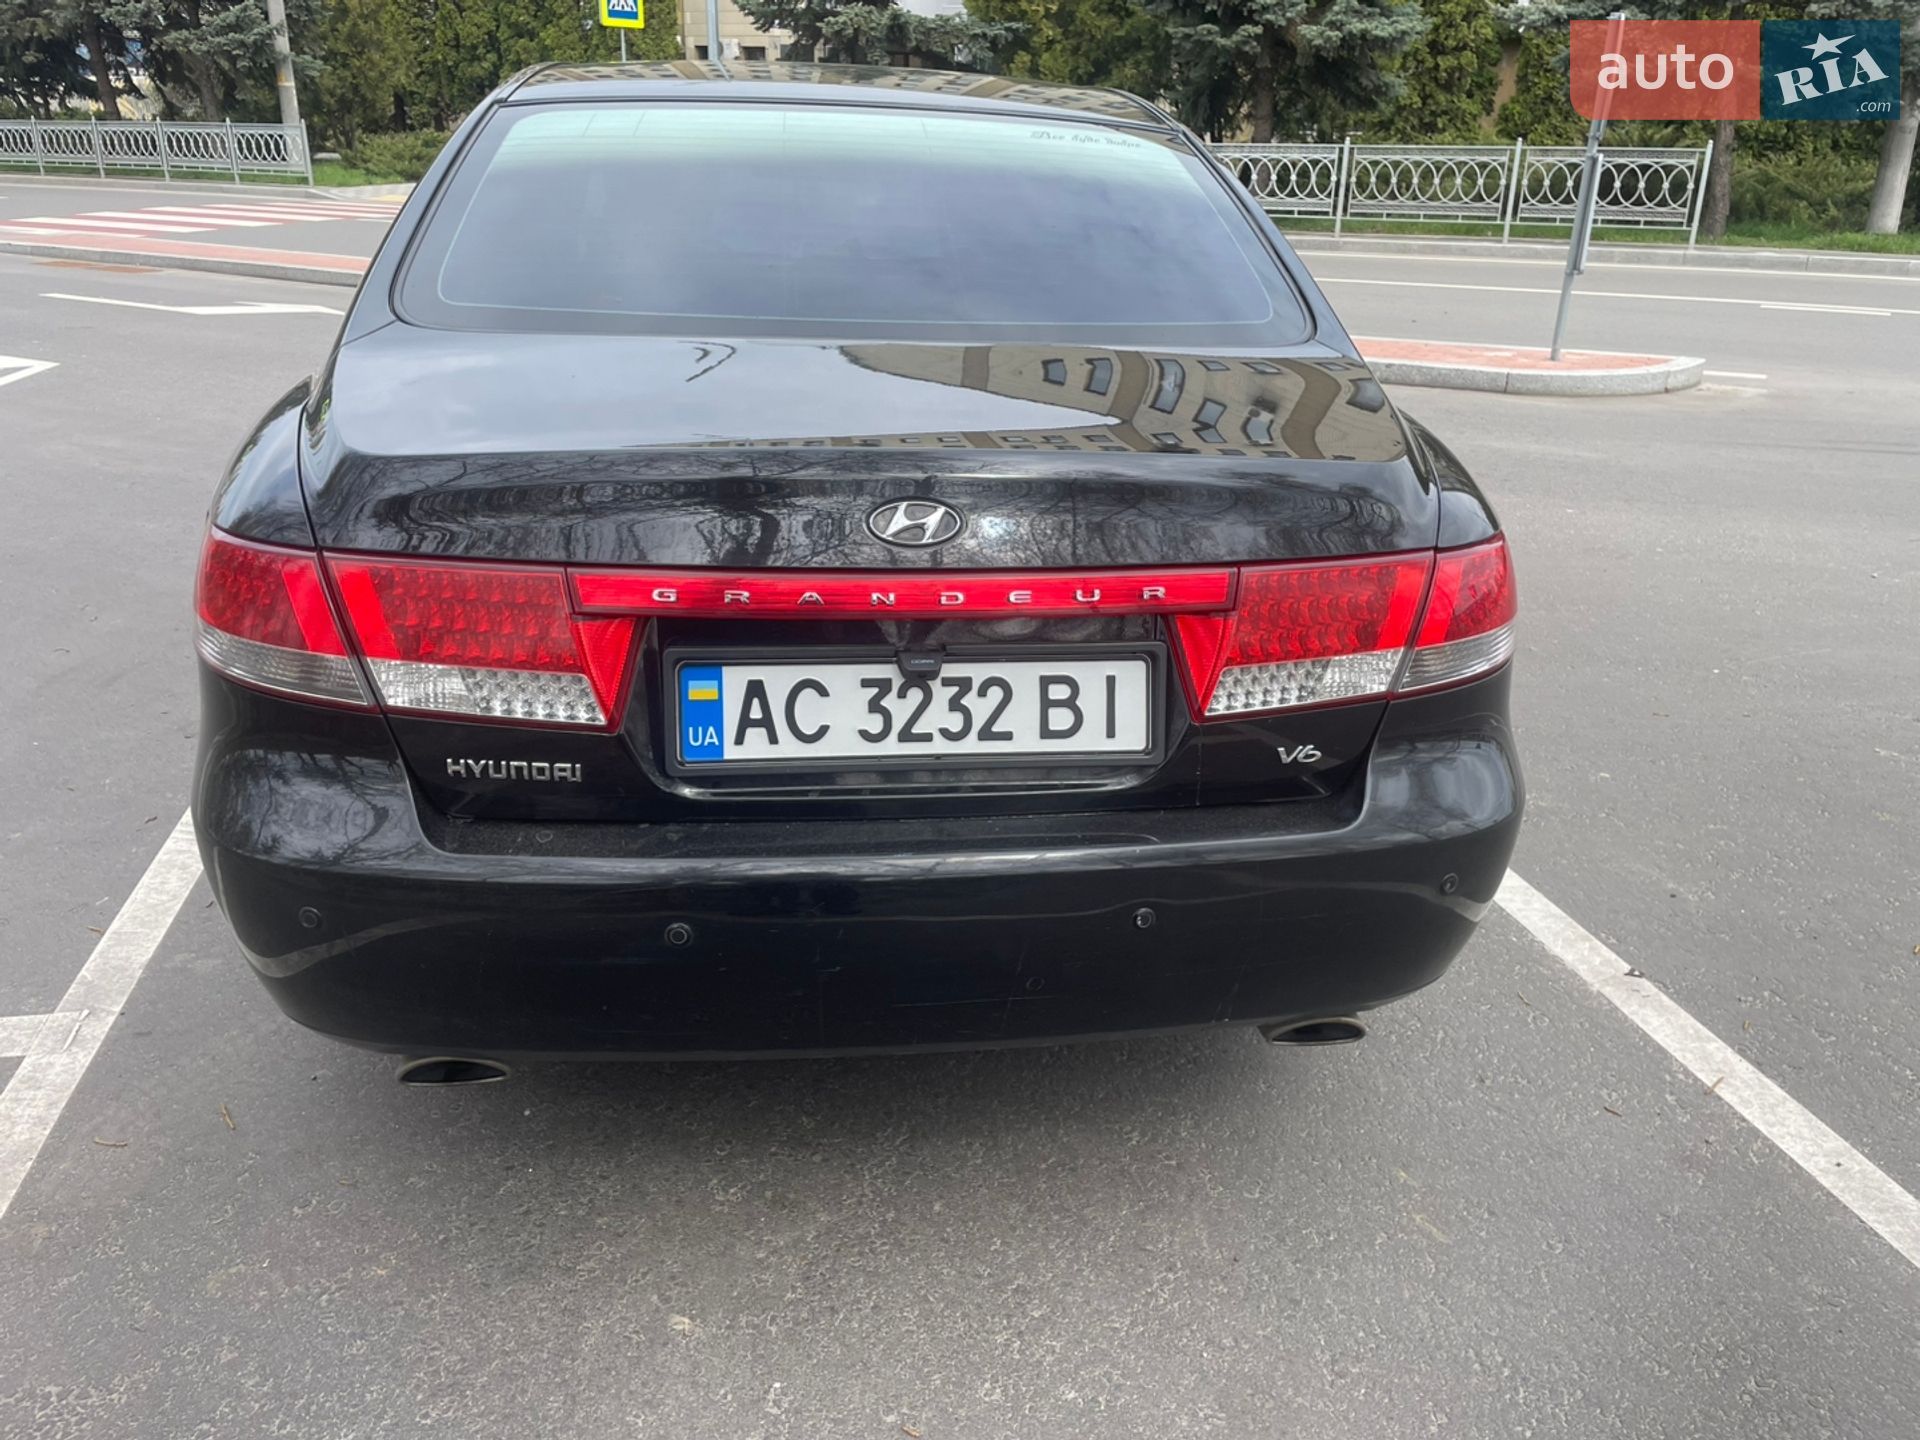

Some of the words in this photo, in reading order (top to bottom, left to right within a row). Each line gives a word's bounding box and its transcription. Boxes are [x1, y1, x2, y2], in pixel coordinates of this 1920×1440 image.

[651, 585, 1167, 606] GRANDEUR
[733, 677, 831, 746] AC
[857, 675, 1014, 744] 3232
[1038, 674, 1116, 740] BI
[688, 725, 720, 747] UA
[1276, 744, 1322, 764] V6
[446, 757, 582, 783] HYUNDAI
